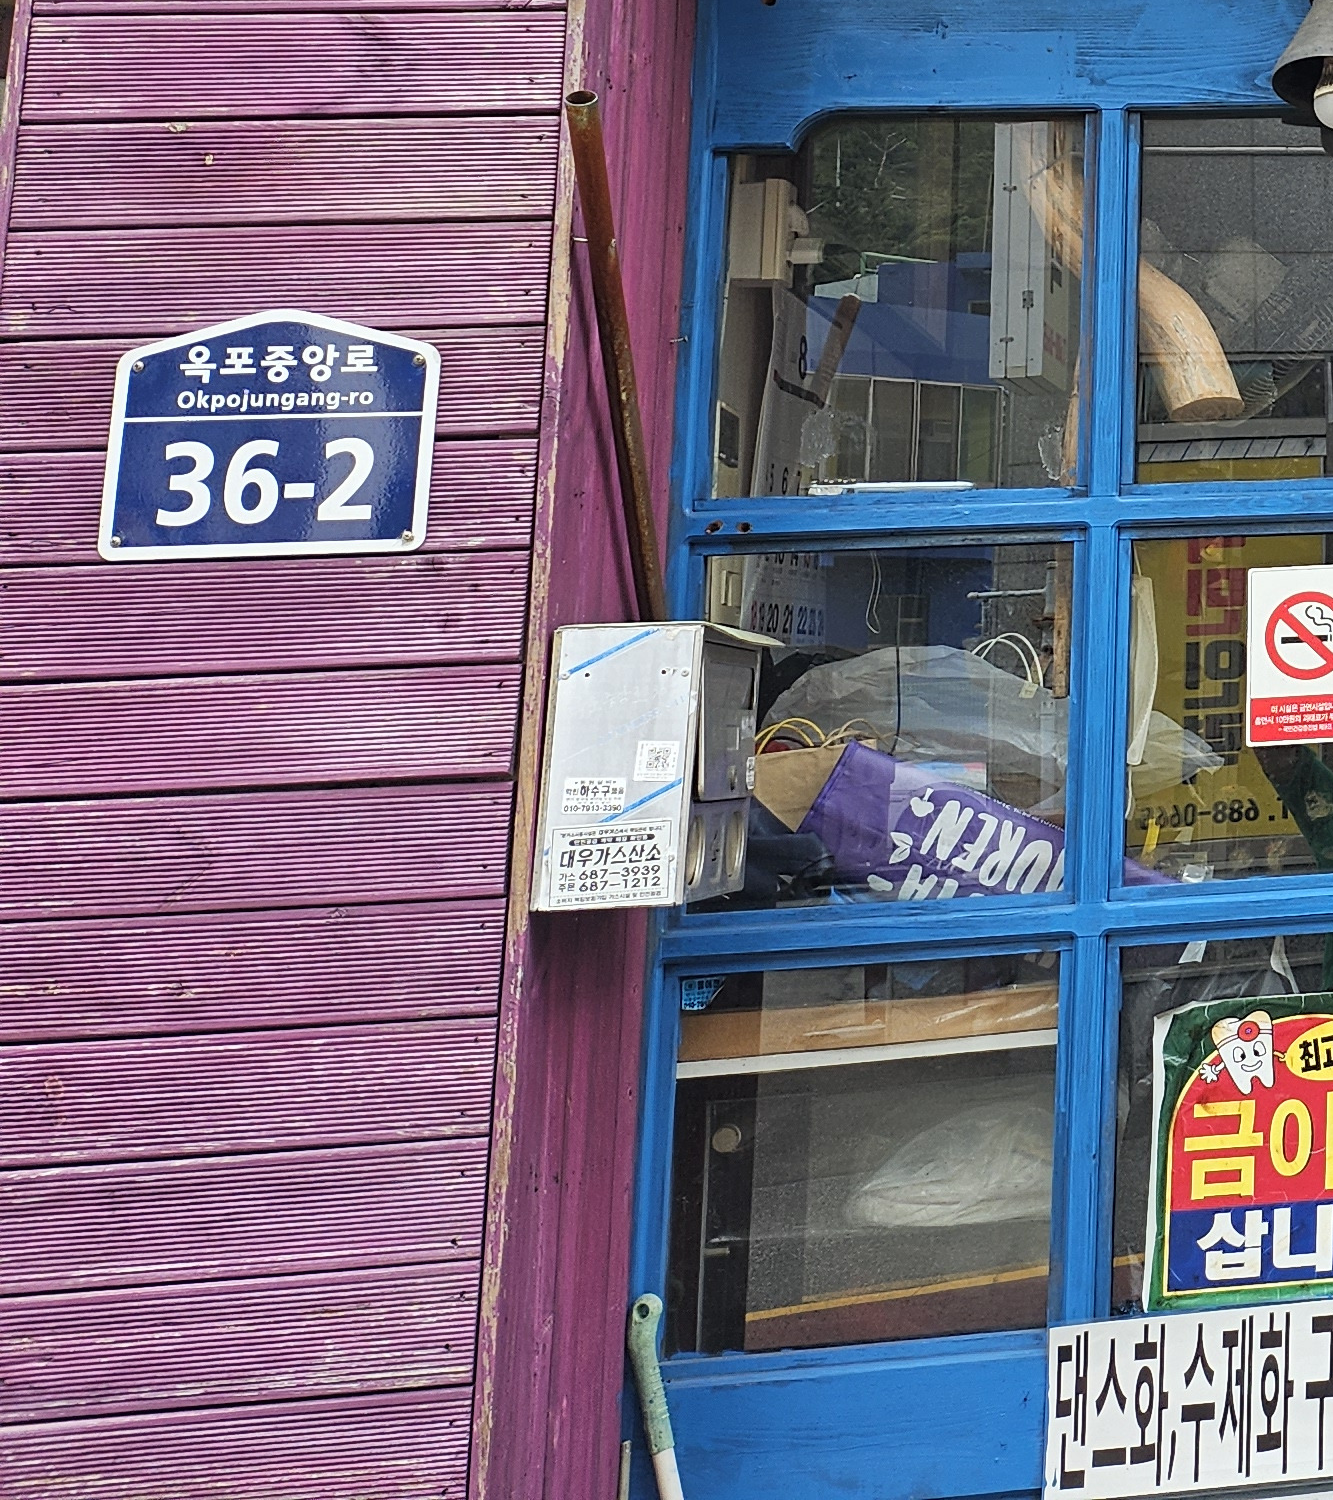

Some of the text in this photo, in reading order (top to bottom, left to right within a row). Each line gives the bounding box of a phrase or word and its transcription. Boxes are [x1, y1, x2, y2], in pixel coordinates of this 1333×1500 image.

[179, 342, 378, 384] 옥포중앙로
[177, 388, 374, 413] Okpojungang-ro
[156, 437, 375, 527] 36-2
[580, 785, 611, 798] 하수구
[559, 843, 661, 869] 대우가스산소
[558, 864, 661, 883] 가스 687-3939
[558, 875, 661, 893] 주문 687-1212
